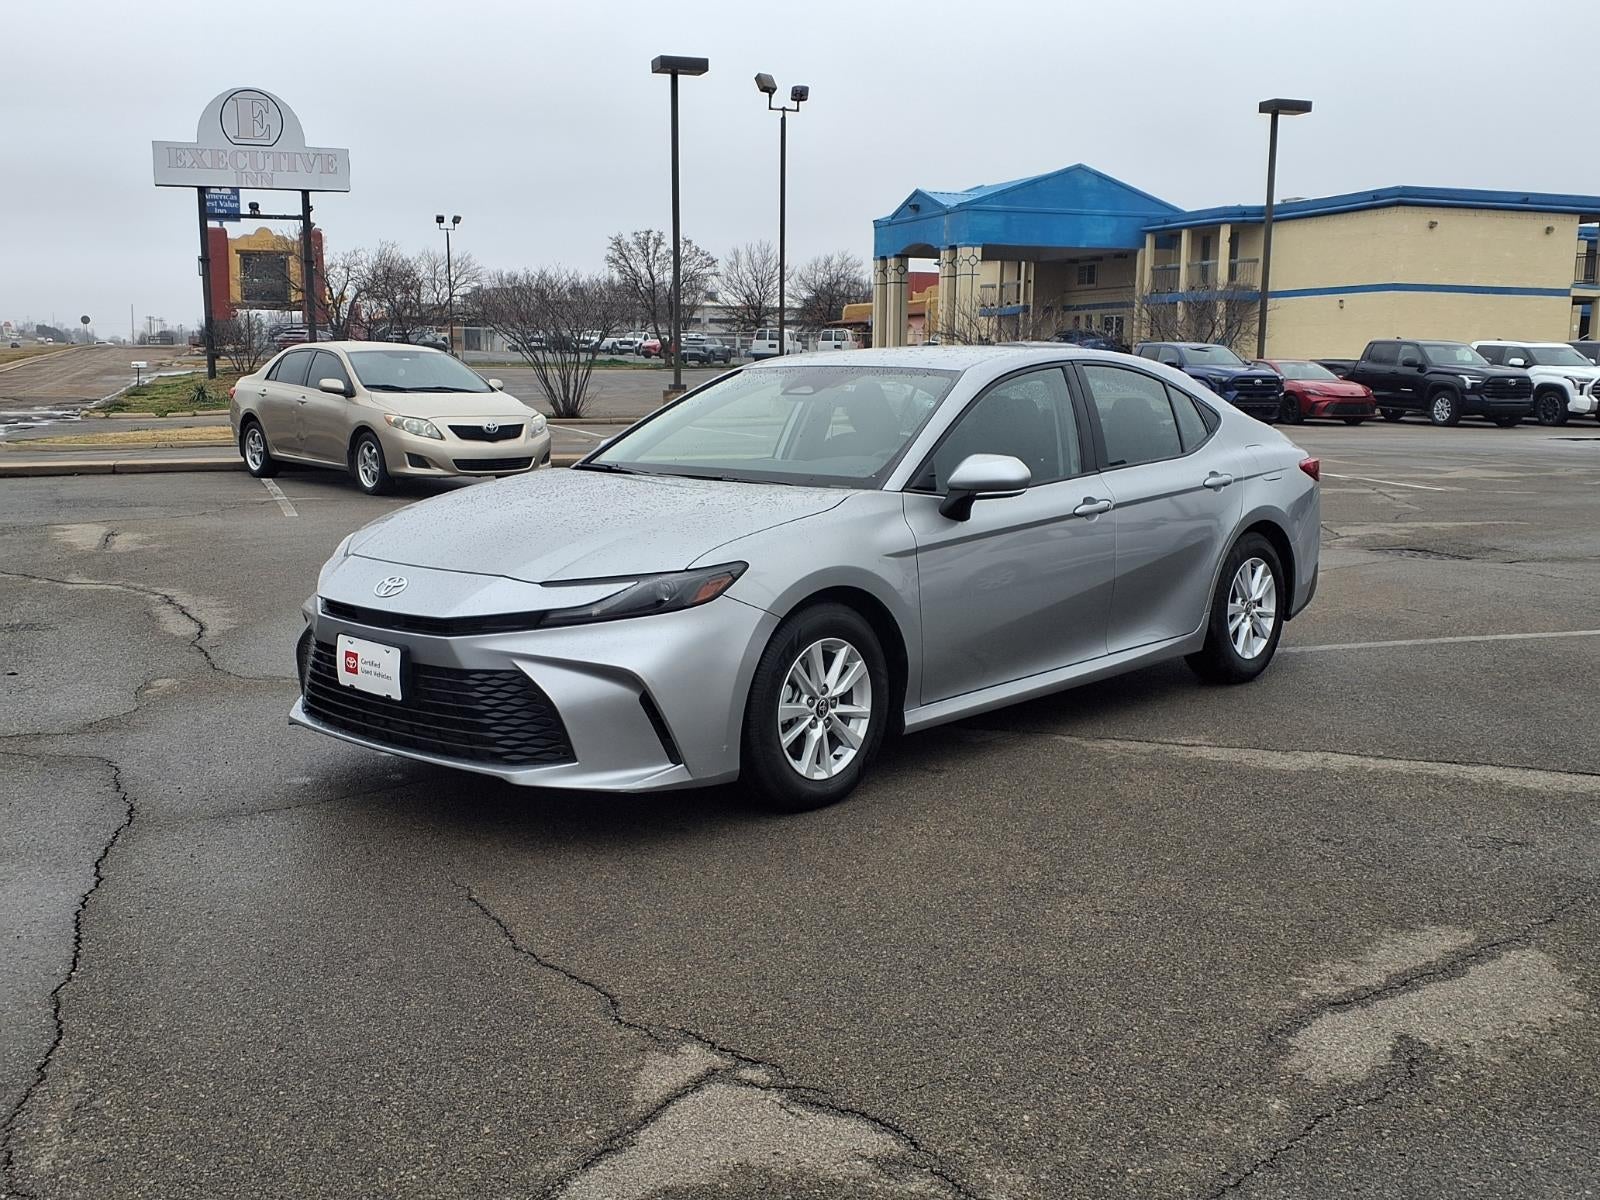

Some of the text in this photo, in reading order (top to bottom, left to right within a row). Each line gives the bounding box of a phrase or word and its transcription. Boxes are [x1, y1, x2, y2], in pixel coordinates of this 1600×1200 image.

[232, 98, 270, 141] E
[167, 147, 338, 174] EXECUTIVE
[234, 171, 274, 186] INN
[219, 200, 240, 208] Value
[361, 658, 381, 668] Certified
[360, 667, 392, 681] Used Vehicles
